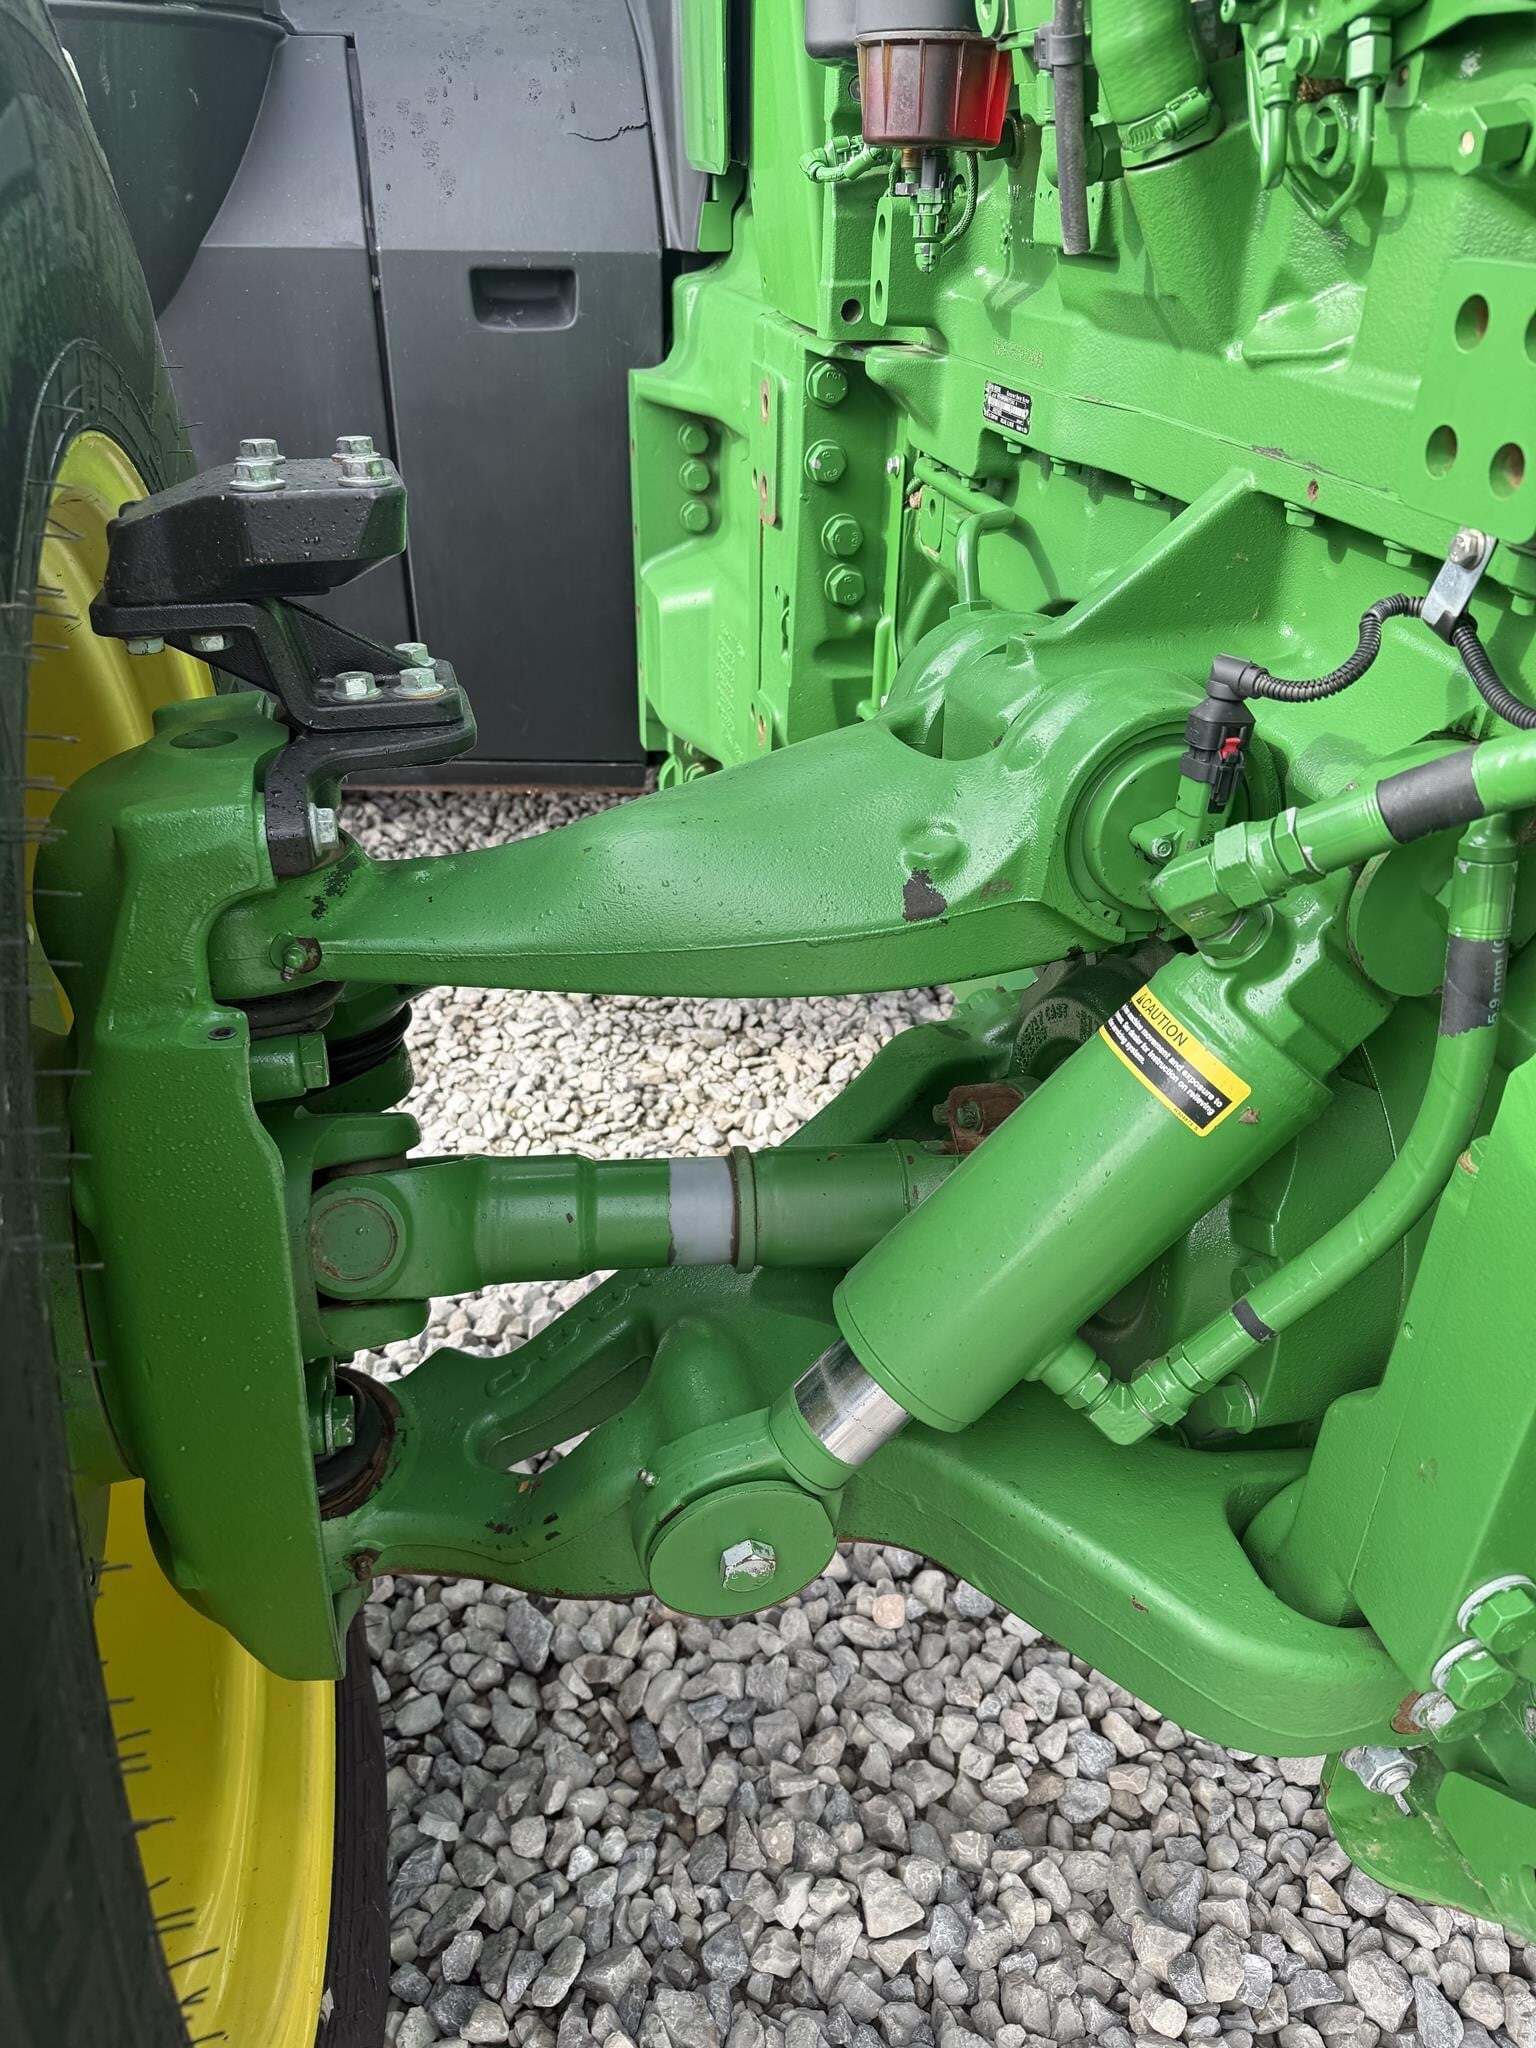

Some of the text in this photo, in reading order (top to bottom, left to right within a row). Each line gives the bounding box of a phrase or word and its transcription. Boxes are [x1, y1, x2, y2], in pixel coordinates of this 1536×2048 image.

[1492, 960, 1504, 992] mm
[1139, 997, 1189, 1046] CAUTION
[1123, 1040, 1148, 1065] system.
[1139, 1027, 1172, 1059] movement
[1167, 1055, 1184, 1072] and
[1180, 1067, 1215, 1102] exposure
[1212, 1097, 1224, 1109] to
[1139, 1041, 1151, 1053] for
[1146, 1049, 1181, 1083] instruction
[1177, 1080, 1188, 1091] on
[1185, 1087, 1215, 1117] relieving
